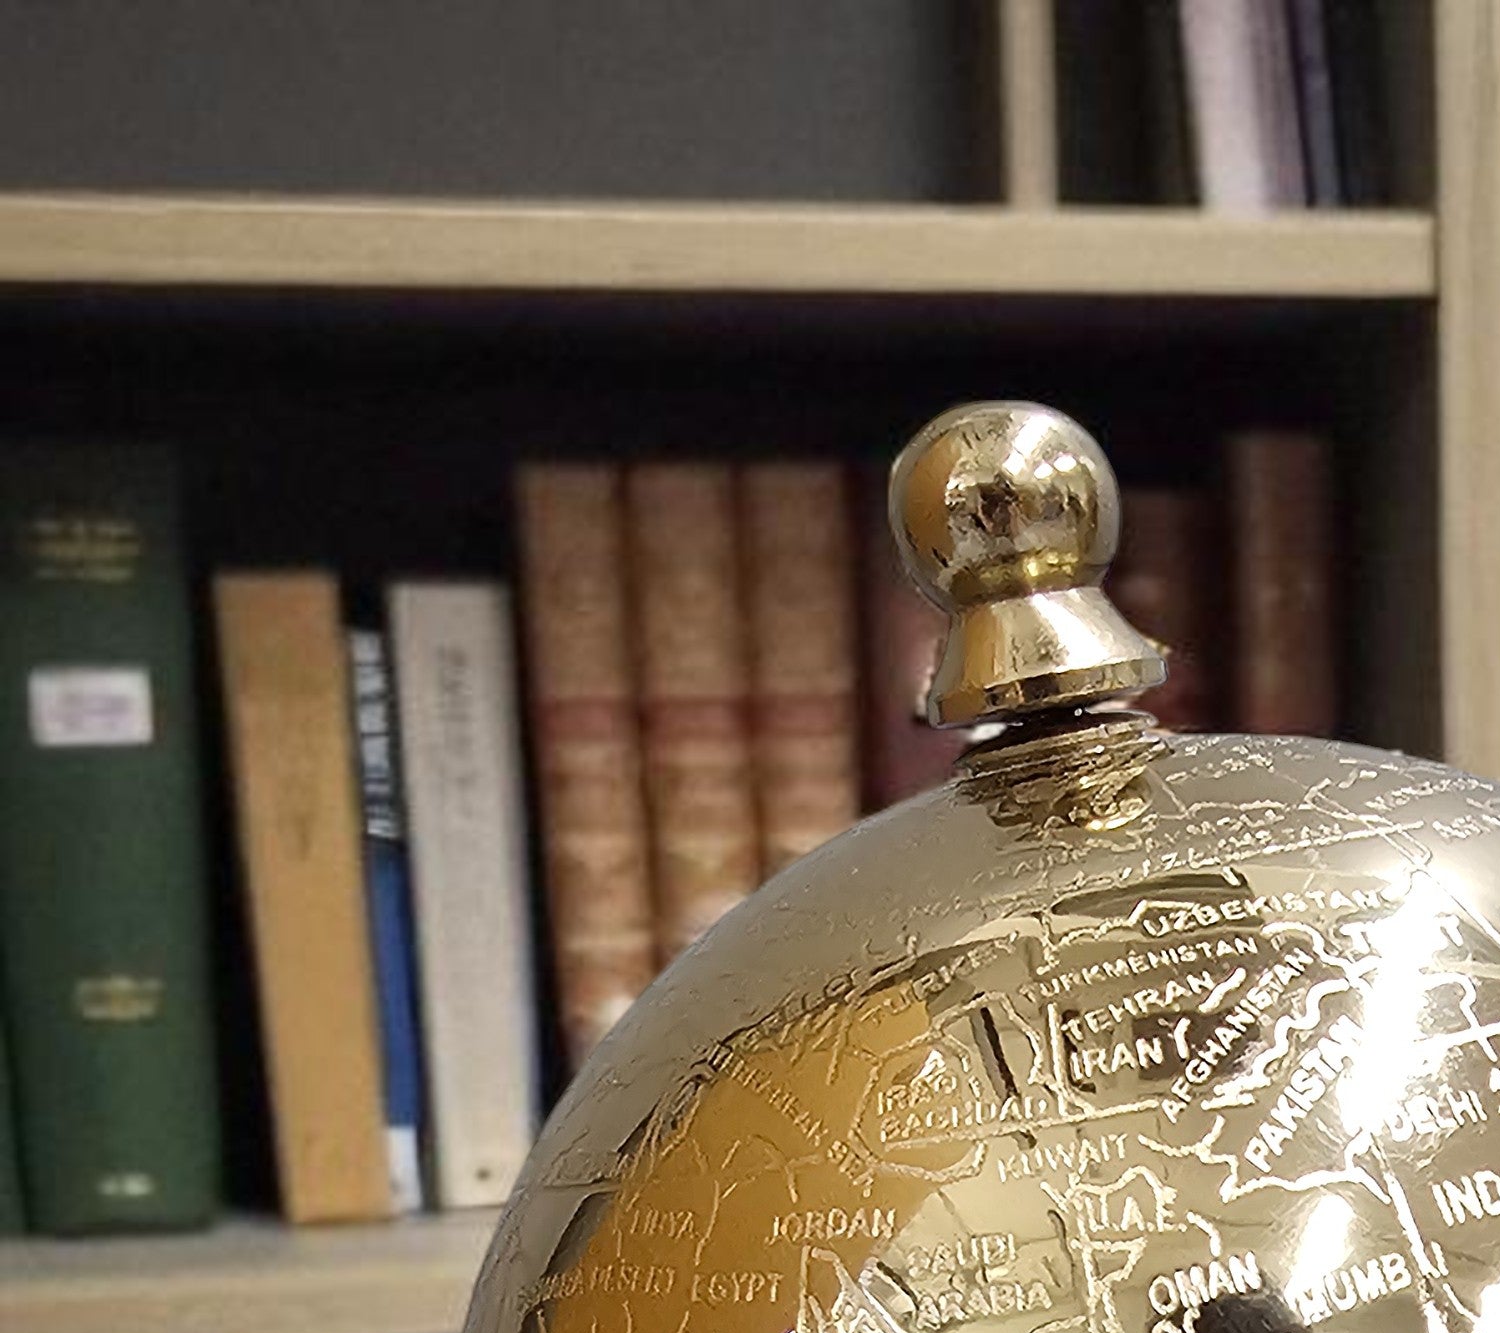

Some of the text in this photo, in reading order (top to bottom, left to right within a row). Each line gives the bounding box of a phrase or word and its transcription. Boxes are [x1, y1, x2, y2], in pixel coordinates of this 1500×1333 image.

[1143, 890, 1393, 938] UZBEKISTAN
[1060, 969, 1214, 1044] TEHRAN
[1070, 1035, 1164, 1081] IRAN
[1159, 946, 1314, 1125] AFGHANISTAN
[1244, 1015, 1364, 1172] PAKISTAN
[1388, 1087, 1488, 1143] DELHI
[997, 1132, 1128, 1183] KUWAIT
[765, 1207, 896, 1246] JORDAN
[691, 1271, 786, 1304] EGYPT
[914, 1280, 1052, 1333] ARABIA
[1147, 1250, 1263, 1314] OMAN
